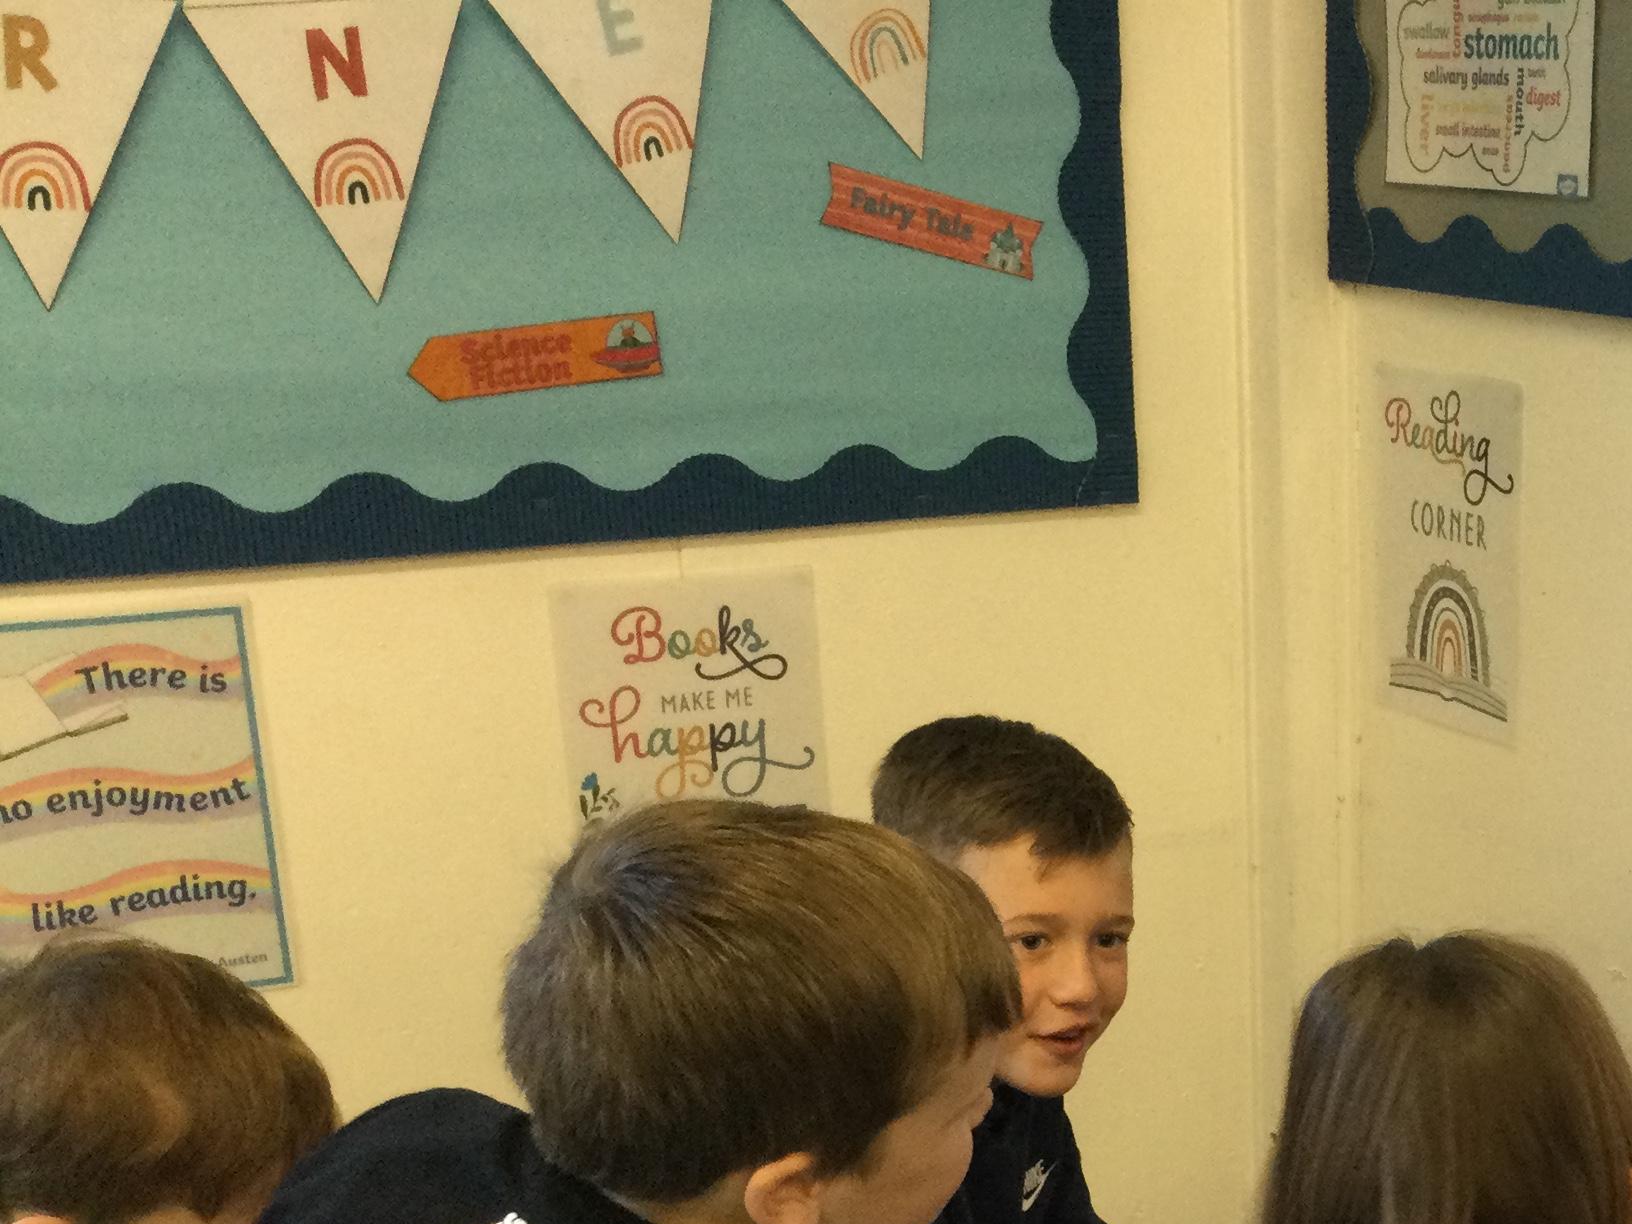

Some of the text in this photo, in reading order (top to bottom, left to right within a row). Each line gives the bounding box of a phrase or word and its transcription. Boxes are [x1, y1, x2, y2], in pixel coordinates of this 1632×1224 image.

[3, 14, 58, 93] R
[304, 26, 368, 101] N
[1464, 22, 1560, 61] stomach
[1424, 66, 1468, 90] salivary
[1471, 67, 1510, 90] glands
[1514, 67, 1525, 137] mouth
[1526, 87, 1561, 112] digest
[850, 186, 975, 242] Fairy Tale
[459, 332, 573, 365] Science
[469, 358, 573, 391] Fiction
[1385, 390, 1514, 506] Reading
[1411, 500, 1488, 551] CORNER
[611, 605, 788, 681] Books
[75, 662, 228, 695] There is
[660, 686, 754, 714] MAKE ME
[579, 685, 815, 800] happy
[46, 778, 251, 817] enjoyment
[31, 873, 256, 932] like reading.
[217, 952, 268, 967] Austen
